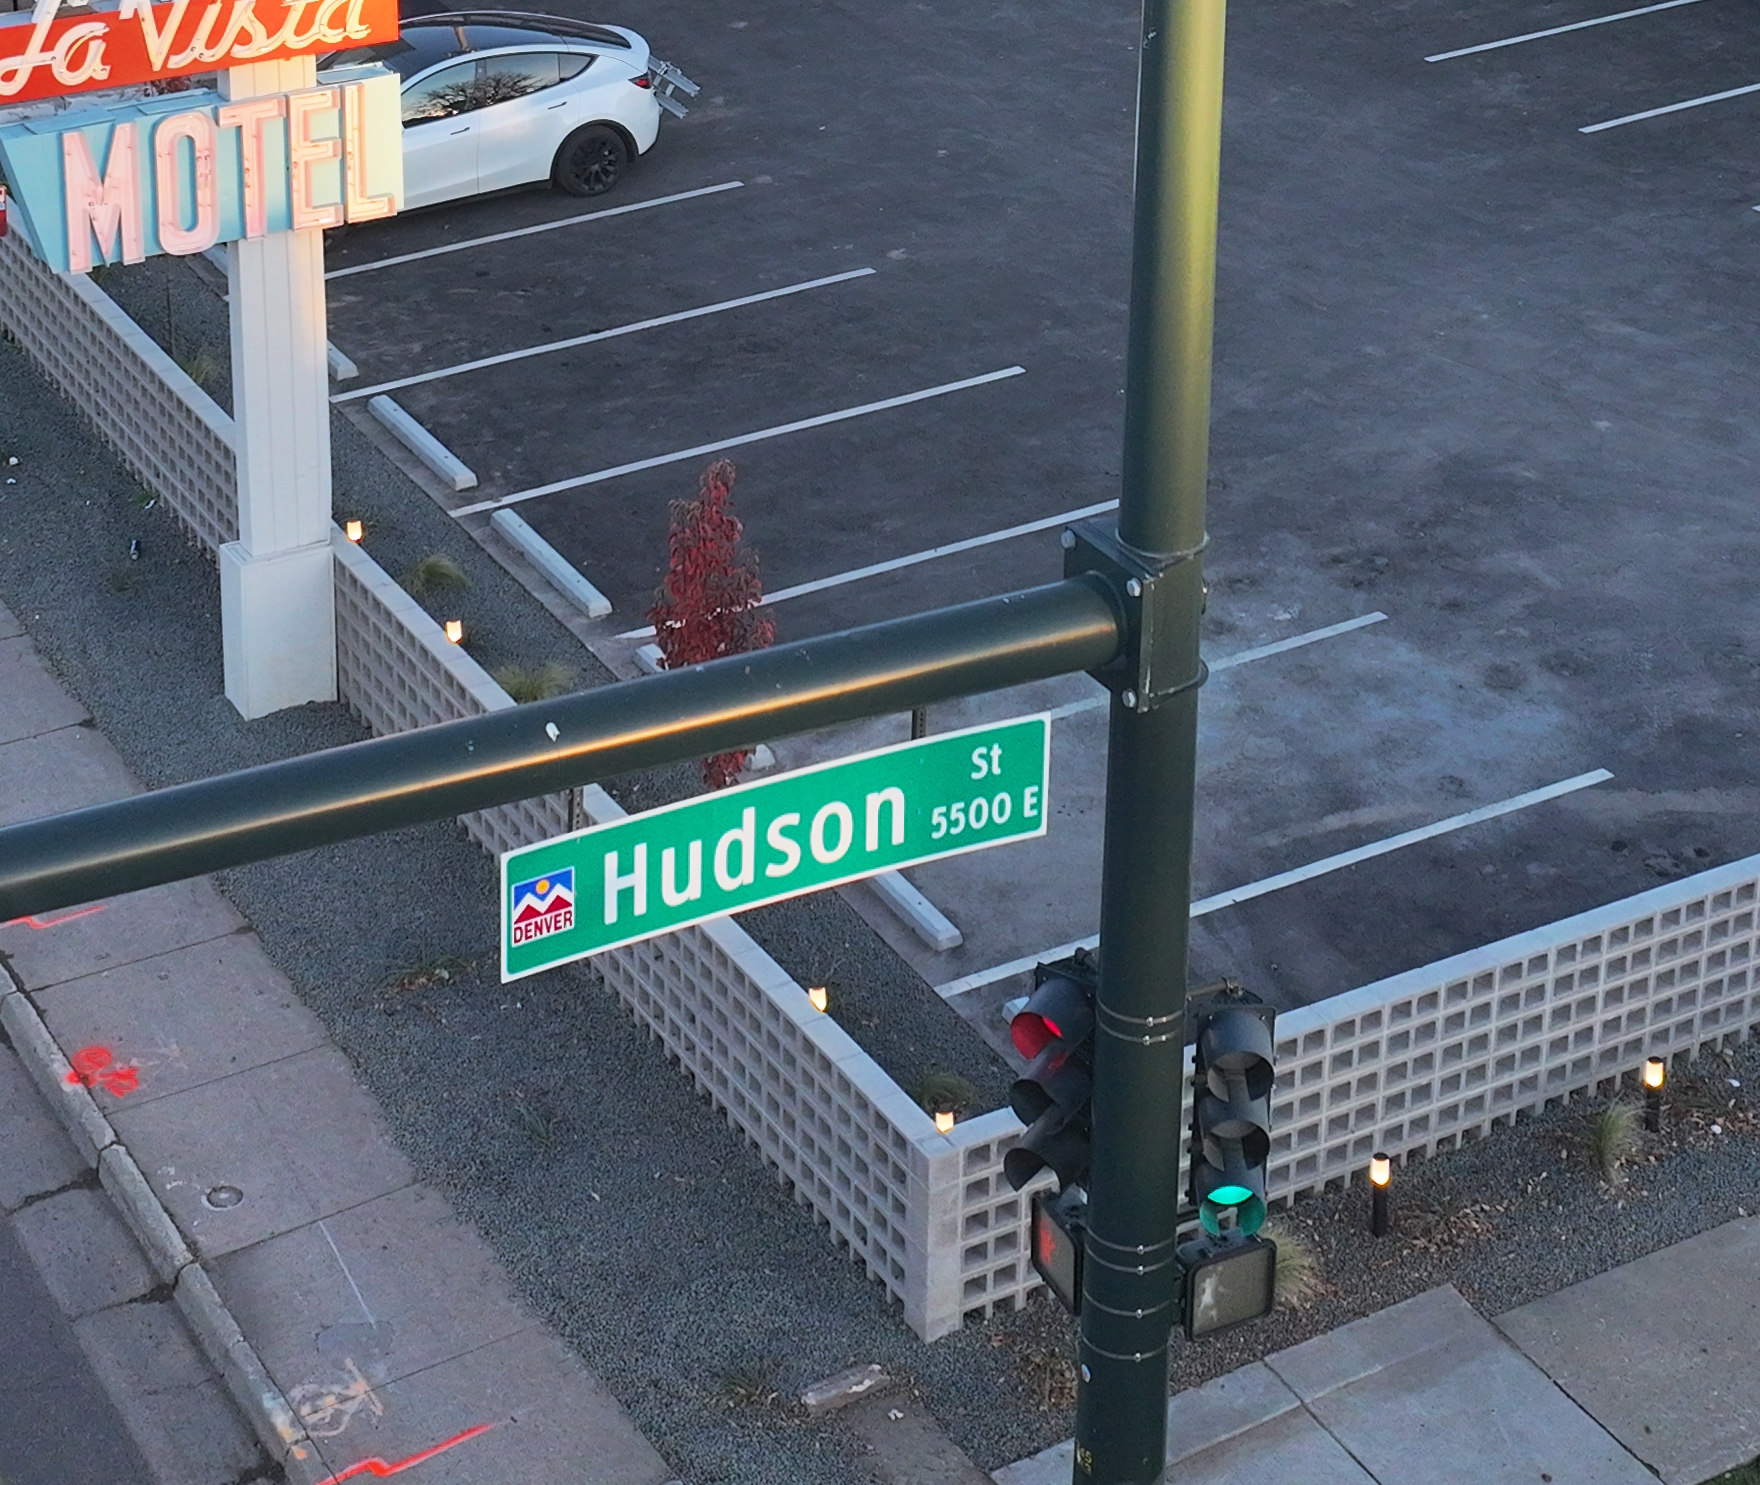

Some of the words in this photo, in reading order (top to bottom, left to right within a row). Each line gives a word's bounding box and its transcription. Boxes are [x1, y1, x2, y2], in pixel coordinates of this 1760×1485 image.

[62, 82, 398, 275] MOTEL
[971, 743, 1002, 780] St
[931, 792, 1012, 840] 5500
[1023, 786, 1039, 817] E
[603, 786, 906, 926] Hudson
[513, 910, 574, 945] DENVER
